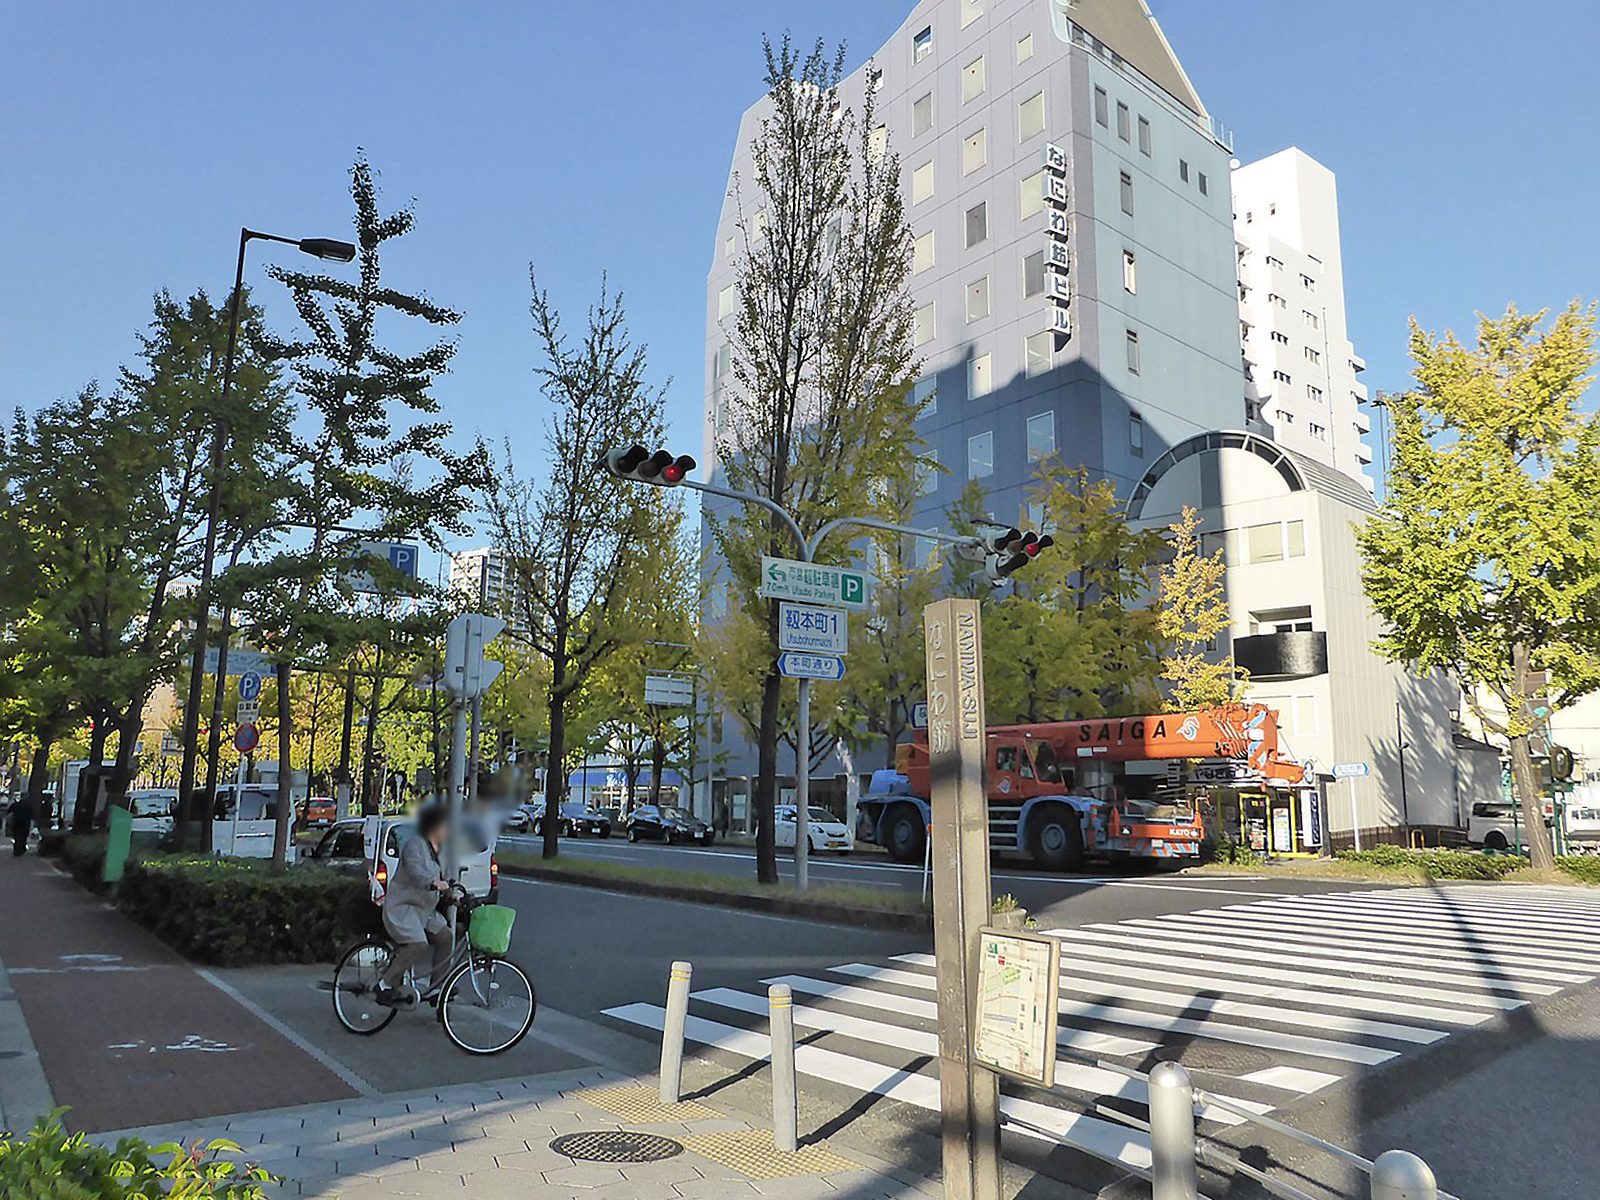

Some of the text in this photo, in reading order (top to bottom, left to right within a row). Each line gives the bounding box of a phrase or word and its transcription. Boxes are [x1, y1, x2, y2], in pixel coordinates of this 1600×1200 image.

[1048, 145, 1068, 332] なにわ筋ビル
[790, 657, 833, 670] 本町通り
[958, 612, 980, 740] NANIWA-SUJI
[1079, 719, 1167, 742] SAIGA
[1169, 828, 1190, 838] KATO
